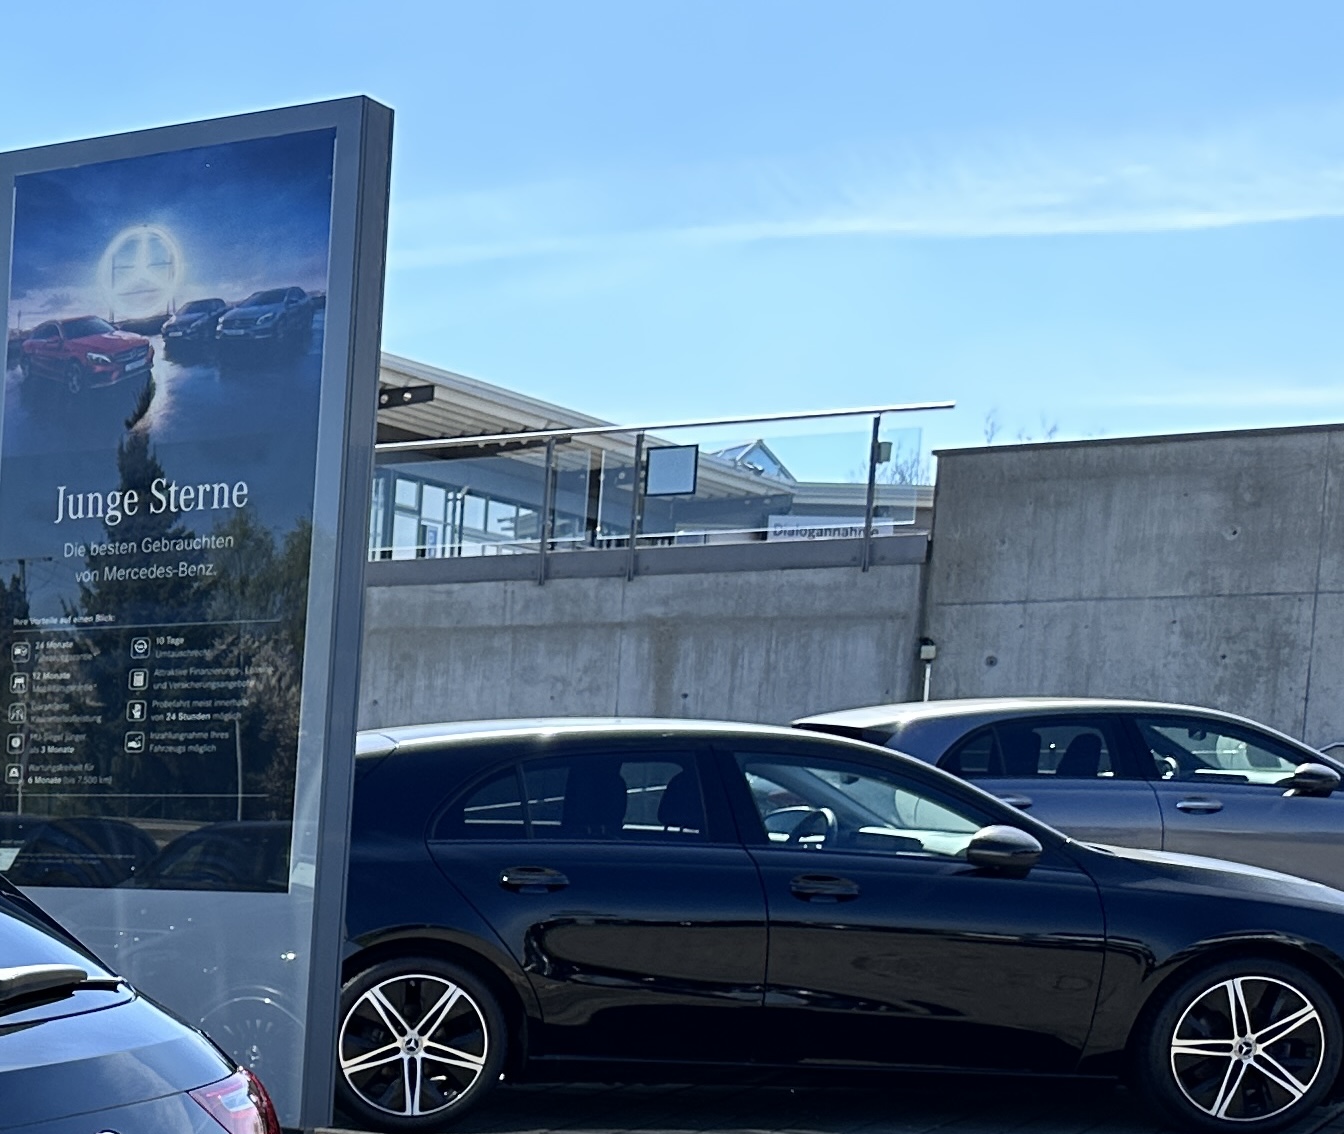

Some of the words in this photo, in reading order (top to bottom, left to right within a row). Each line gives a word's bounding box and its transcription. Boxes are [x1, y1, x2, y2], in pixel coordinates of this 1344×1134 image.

[53, 485, 139, 526] Junge
[150, 478, 249, 514] Sterne
[773, 523, 879, 539] Dialogannahe
[64, 542, 86, 558] Die
[90, 541, 137, 556] besten
[141, 535, 234, 553] Gebrauchten
[75, 569, 99, 583] von
[103, 561, 217, 581] Mercedes-Benz.
[166, 636, 185, 646] Tage
[165, 712, 176, 721] 24
[178, 712, 211, 720] Stunden
[47, 746, 75, 754] Monate
